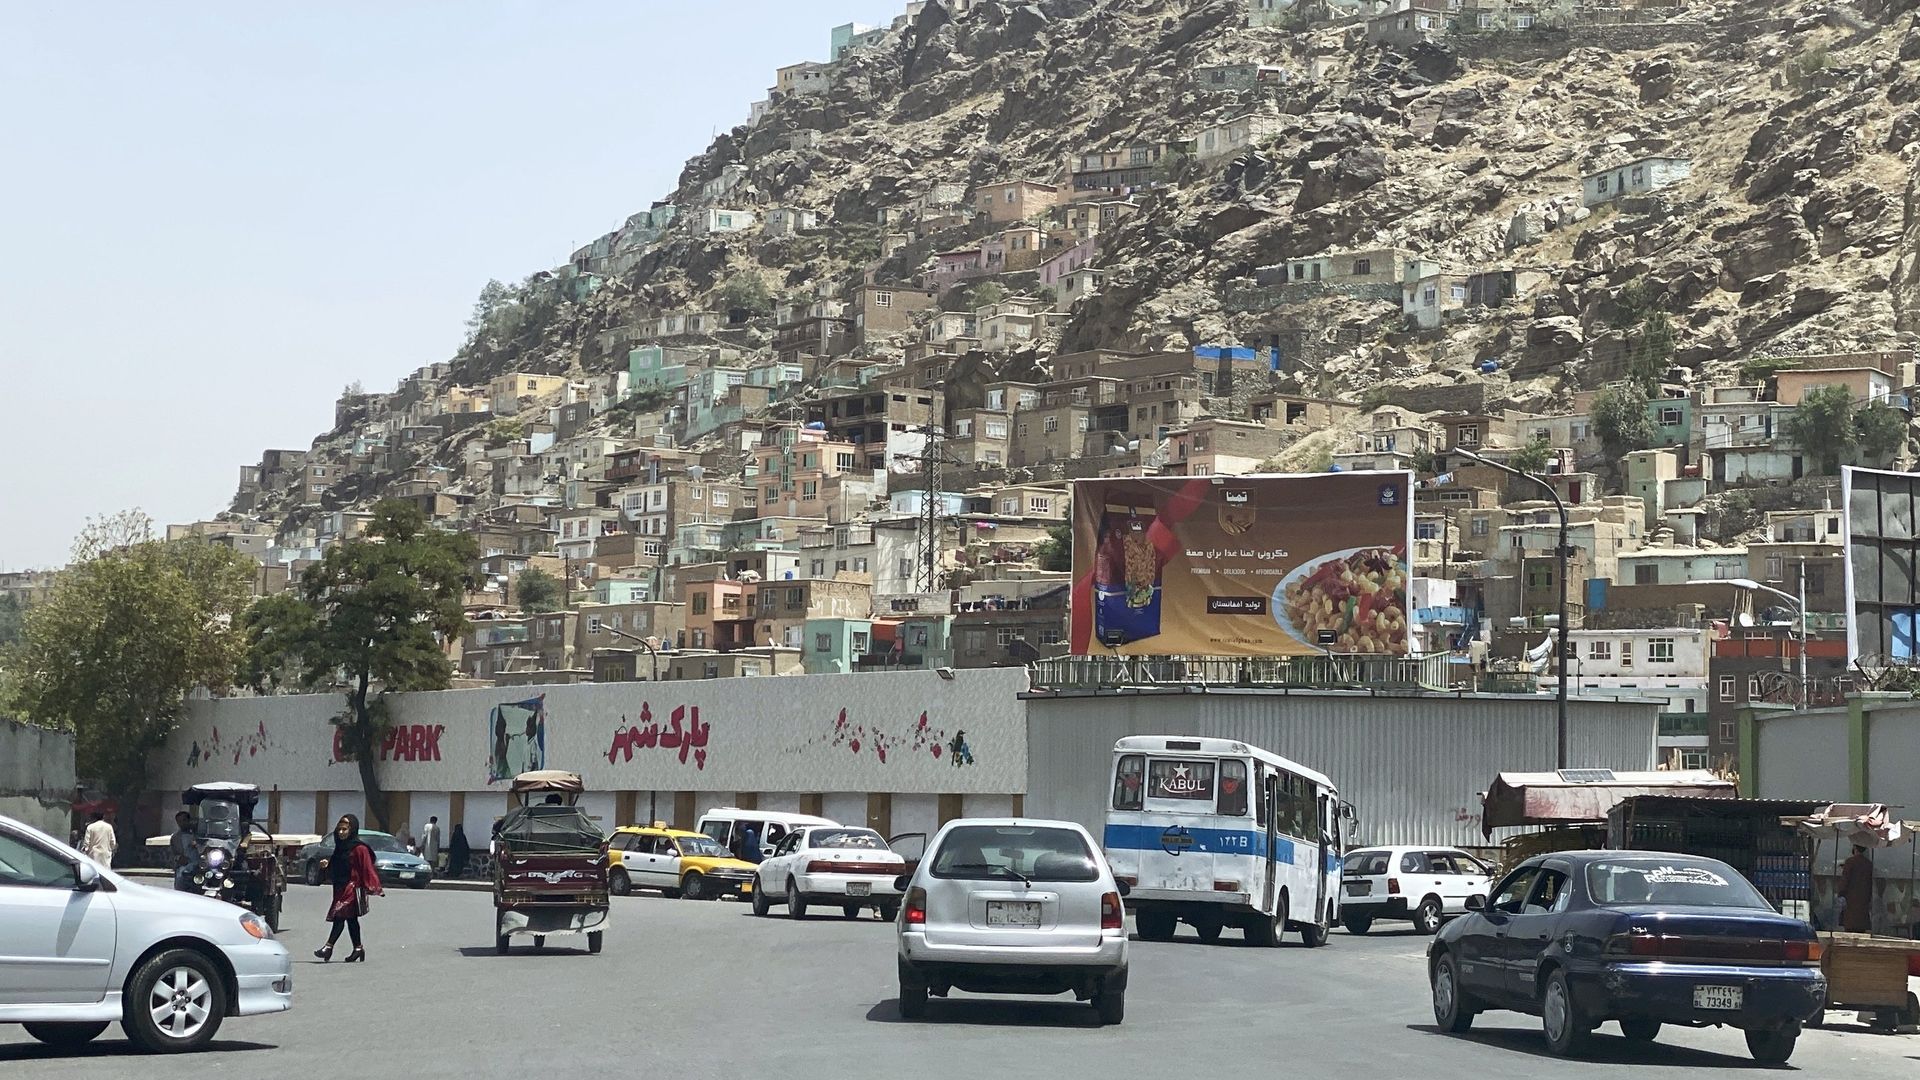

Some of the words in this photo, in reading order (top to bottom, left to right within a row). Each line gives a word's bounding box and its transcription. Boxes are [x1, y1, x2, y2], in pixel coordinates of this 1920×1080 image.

[380, 724, 442, 762] PARK
[607, 701, 660, 766] شهر
[660, 704, 710, 771] پارک
[1160, 778, 1206, 793] KABUL
[1706, 996, 1732, 1008] 73349
